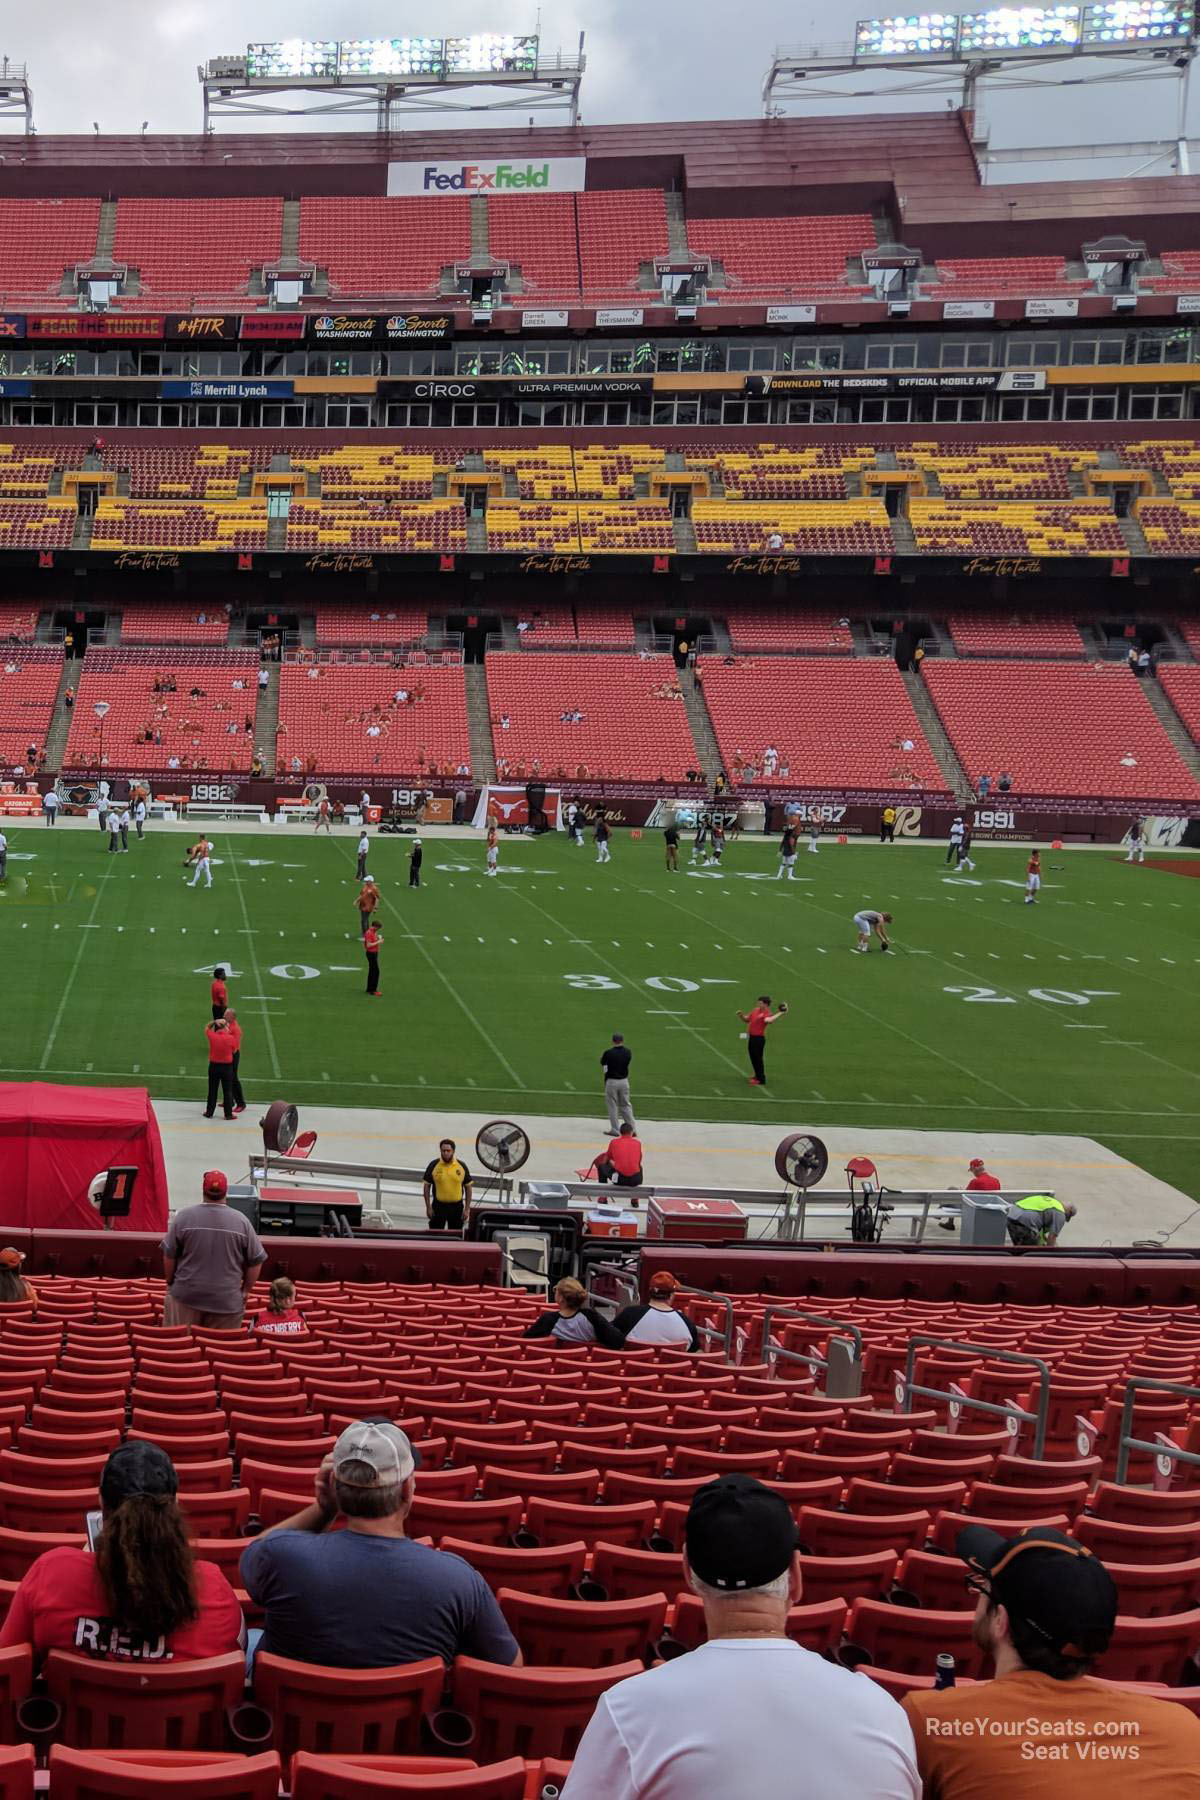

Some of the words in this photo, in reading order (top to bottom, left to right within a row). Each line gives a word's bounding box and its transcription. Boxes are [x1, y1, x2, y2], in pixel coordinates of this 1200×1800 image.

[424, 164, 549, 190] FedExField
[32, 319, 78, 334] #FEAR
[80, 320, 105, 333] THE
[105, 319, 159, 334] TURTLE
[333, 317, 377, 331] Sports
[406, 316, 449, 331] Sports
[388, 330, 445, 338] WASHINGTON
[552, 384, 603, 392] PREMIUM
[605, 383, 641, 391] VODKA
[771, 379, 821, 389] DOWNLOAD
[823, 379, 840, 387] THE
[843, 378, 888, 387] REDSKINS
[899, 377, 938, 386] OFFICIAL
[940, 377, 974, 386] MOBILE
[976, 376, 995, 384] APP
[204, 384, 237, 396] Merrill
[239, 385, 268, 397] Lynch
[190, 784, 232, 801] 1982
[973, 811, 1016, 829] 1991
[113, 1174, 127, 1198] 1
[608, 1225, 621, 1238] G
